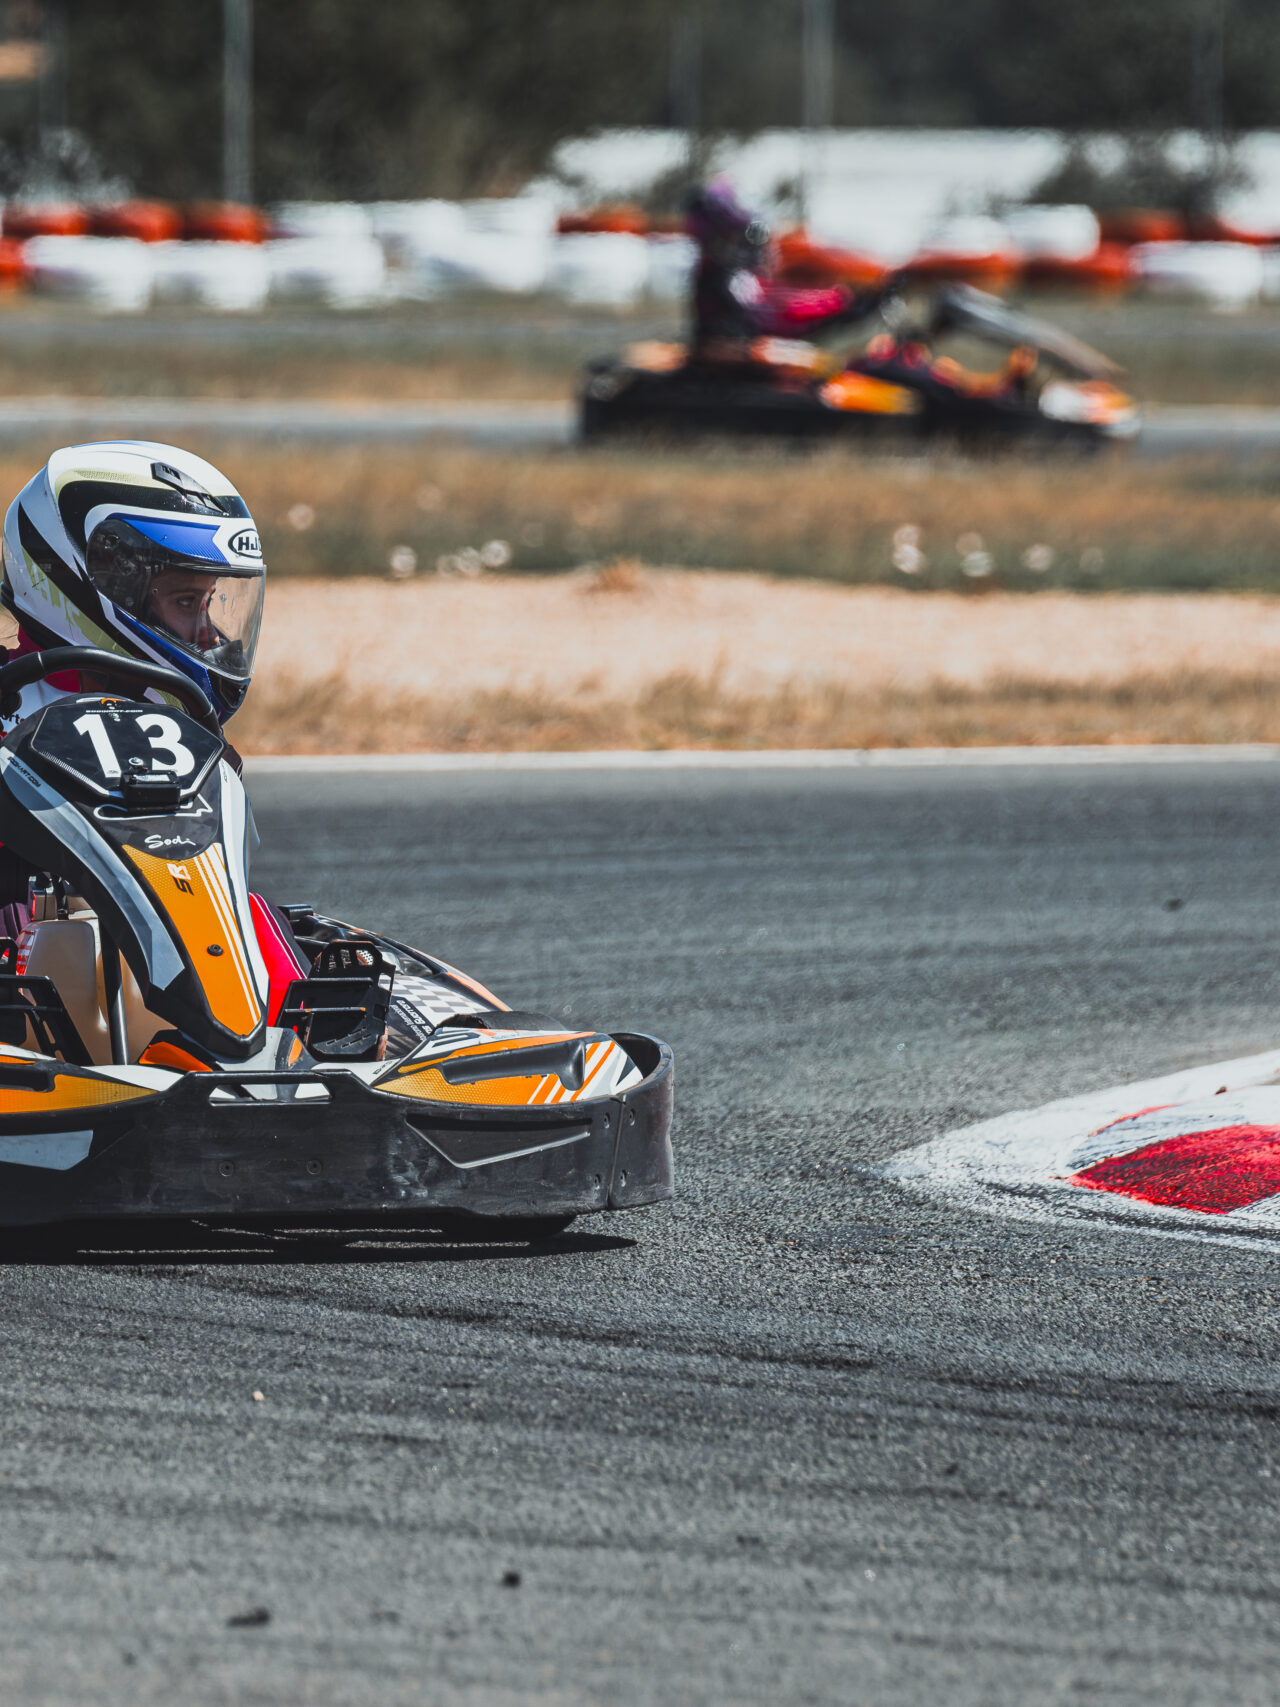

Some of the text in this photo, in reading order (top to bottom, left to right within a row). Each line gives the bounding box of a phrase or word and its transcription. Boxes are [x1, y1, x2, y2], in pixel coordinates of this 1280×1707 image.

[237, 536, 261, 551] HJ
[73, 714, 196, 778] 13
[145, 834, 196, 849] Sodi
